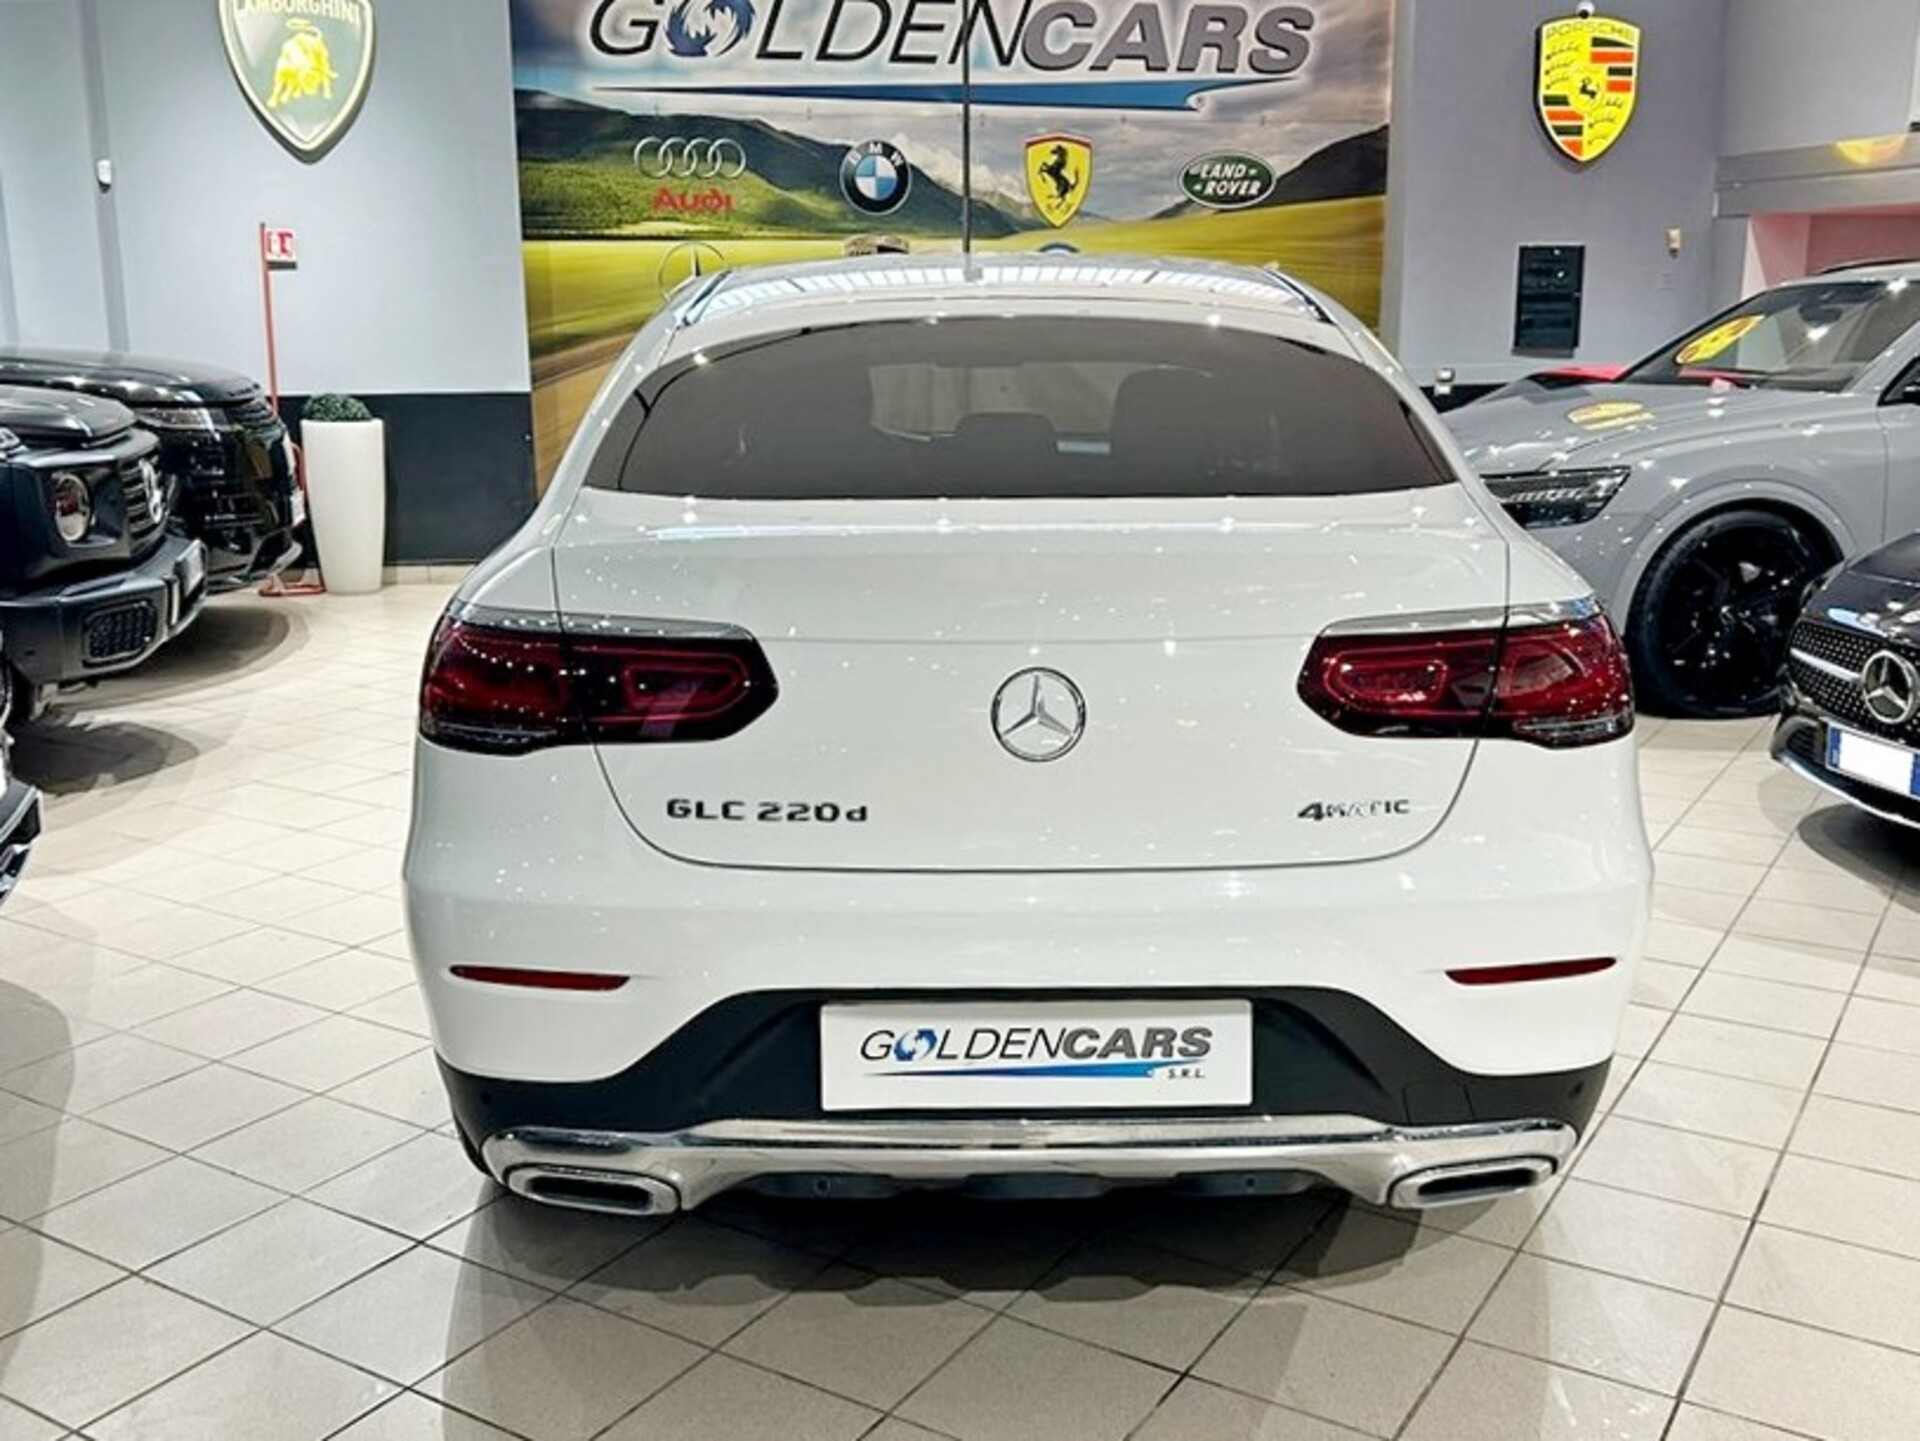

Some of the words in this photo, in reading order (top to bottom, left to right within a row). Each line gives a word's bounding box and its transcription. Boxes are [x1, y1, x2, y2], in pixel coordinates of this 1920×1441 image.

[589, 0, 1314, 74] GOLDENCARS
[1545, 20, 1637, 42] PORSCHE
[849, 141, 905, 166] BMW
[1200, 164, 1247, 179] LAND
[1204, 180, 1262, 196] ROVER
[652, 187, 734, 213] Audi
[666, 798, 745, 820] GLC
[860, 1026, 1214, 1062] GOLDENCARS
